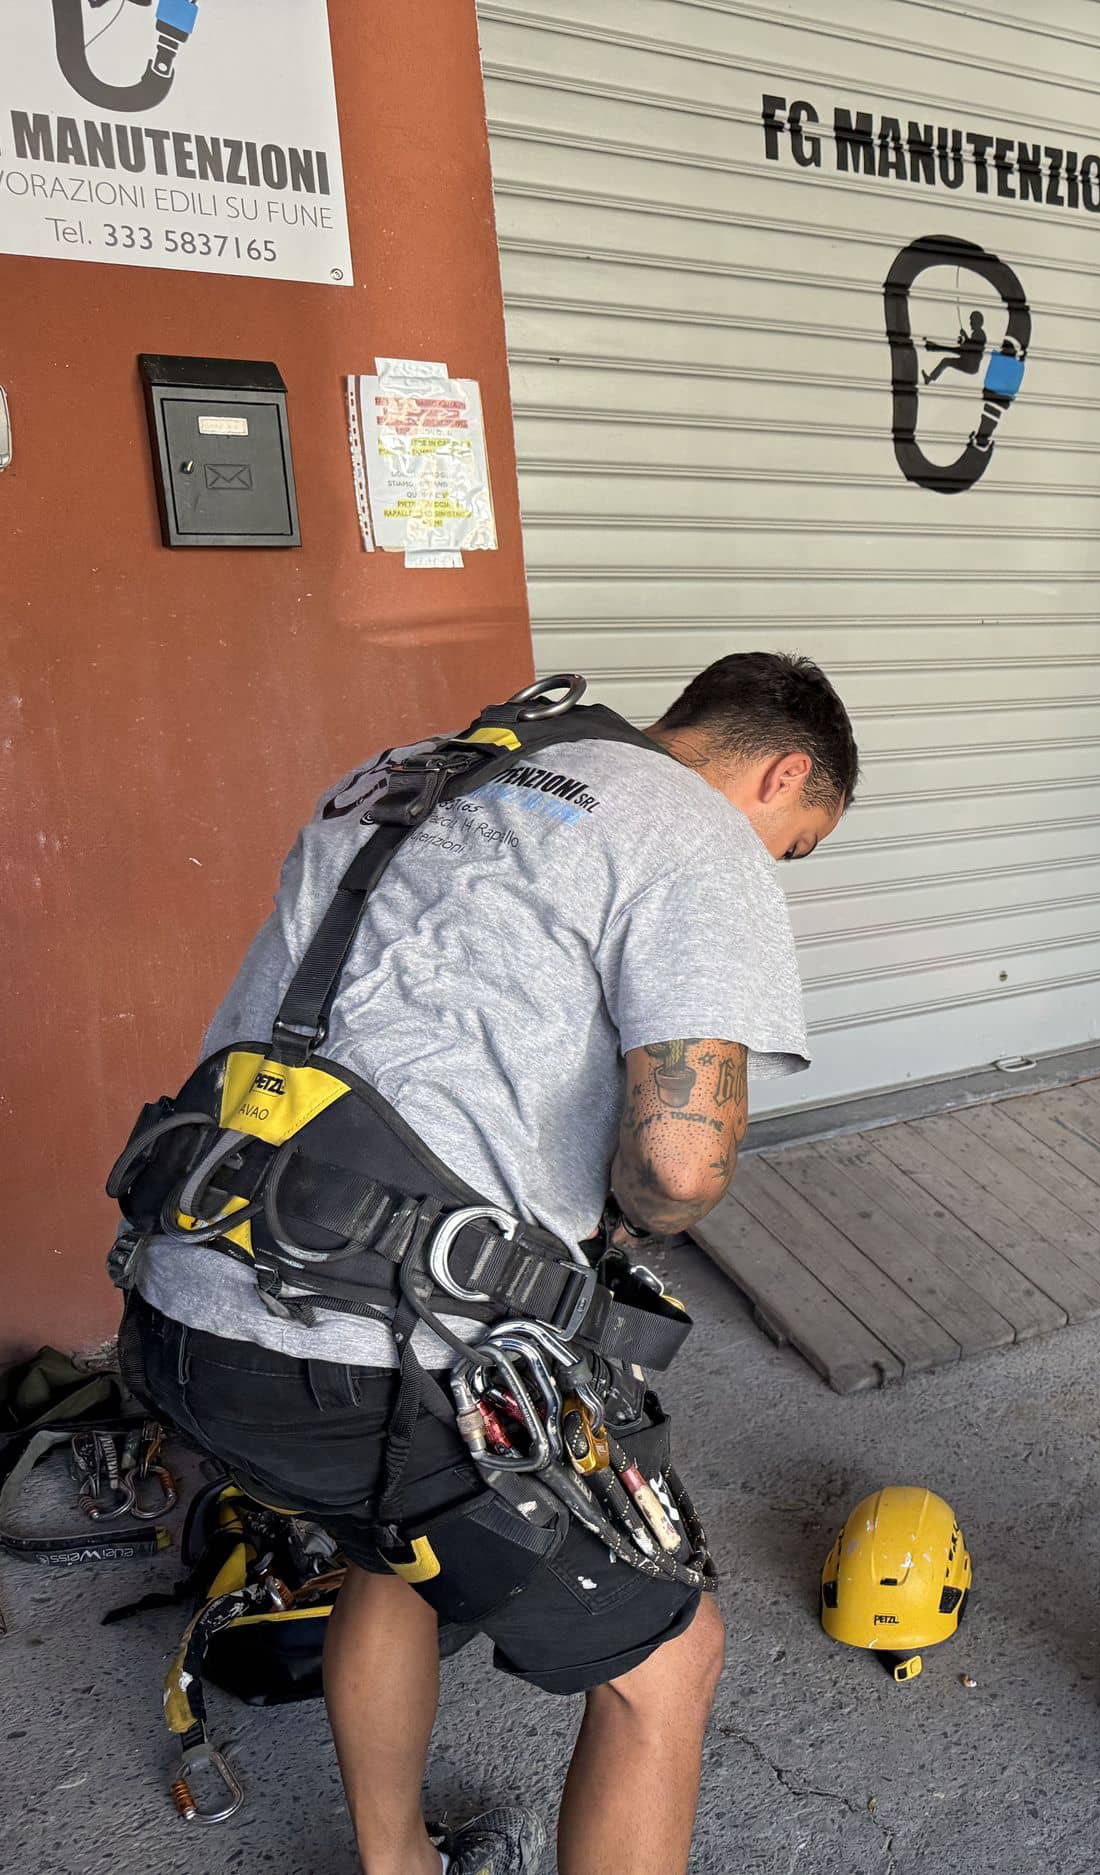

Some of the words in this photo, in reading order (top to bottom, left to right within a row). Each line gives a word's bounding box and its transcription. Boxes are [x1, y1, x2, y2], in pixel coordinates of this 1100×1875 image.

[10, 110, 330, 195] MANUTENZIONI
[762, 94, 822, 168] FG
[155, 188, 217, 217] EDILI
[226, 196, 259, 222] SU
[267, 201, 334, 230] FUNE
[45, 217, 93, 245] Tel.
[104, 223, 153, 250] 333
[164, 230, 278, 262] 5837165
[487, 767, 589, 801] TENZIONI
[574, 793, 600, 813] SRL
[251, 1073, 286, 1096] PETZL
[239, 1103, 270, 1121] AVAO
[873, 1614, 900, 1626] PETZL
